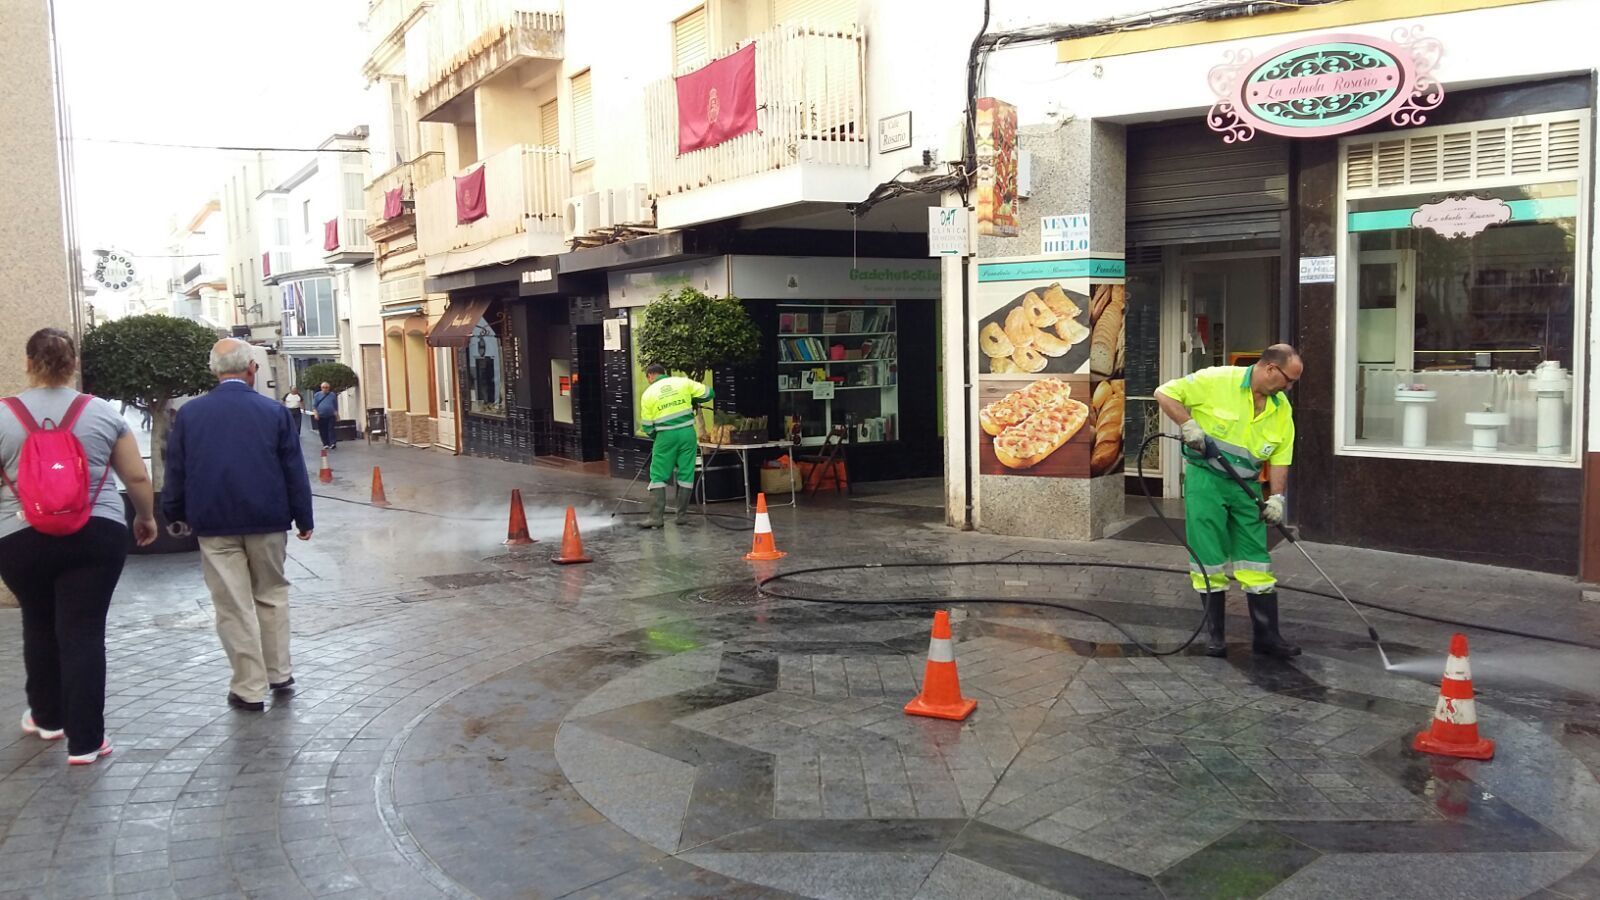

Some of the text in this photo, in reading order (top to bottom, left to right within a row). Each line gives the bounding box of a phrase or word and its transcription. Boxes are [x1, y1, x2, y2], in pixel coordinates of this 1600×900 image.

[1267, 74, 1378, 99] La abuela Rosario
[1043, 215, 1088, 230] VENTA
[1044, 239, 1088, 252] HIELO
